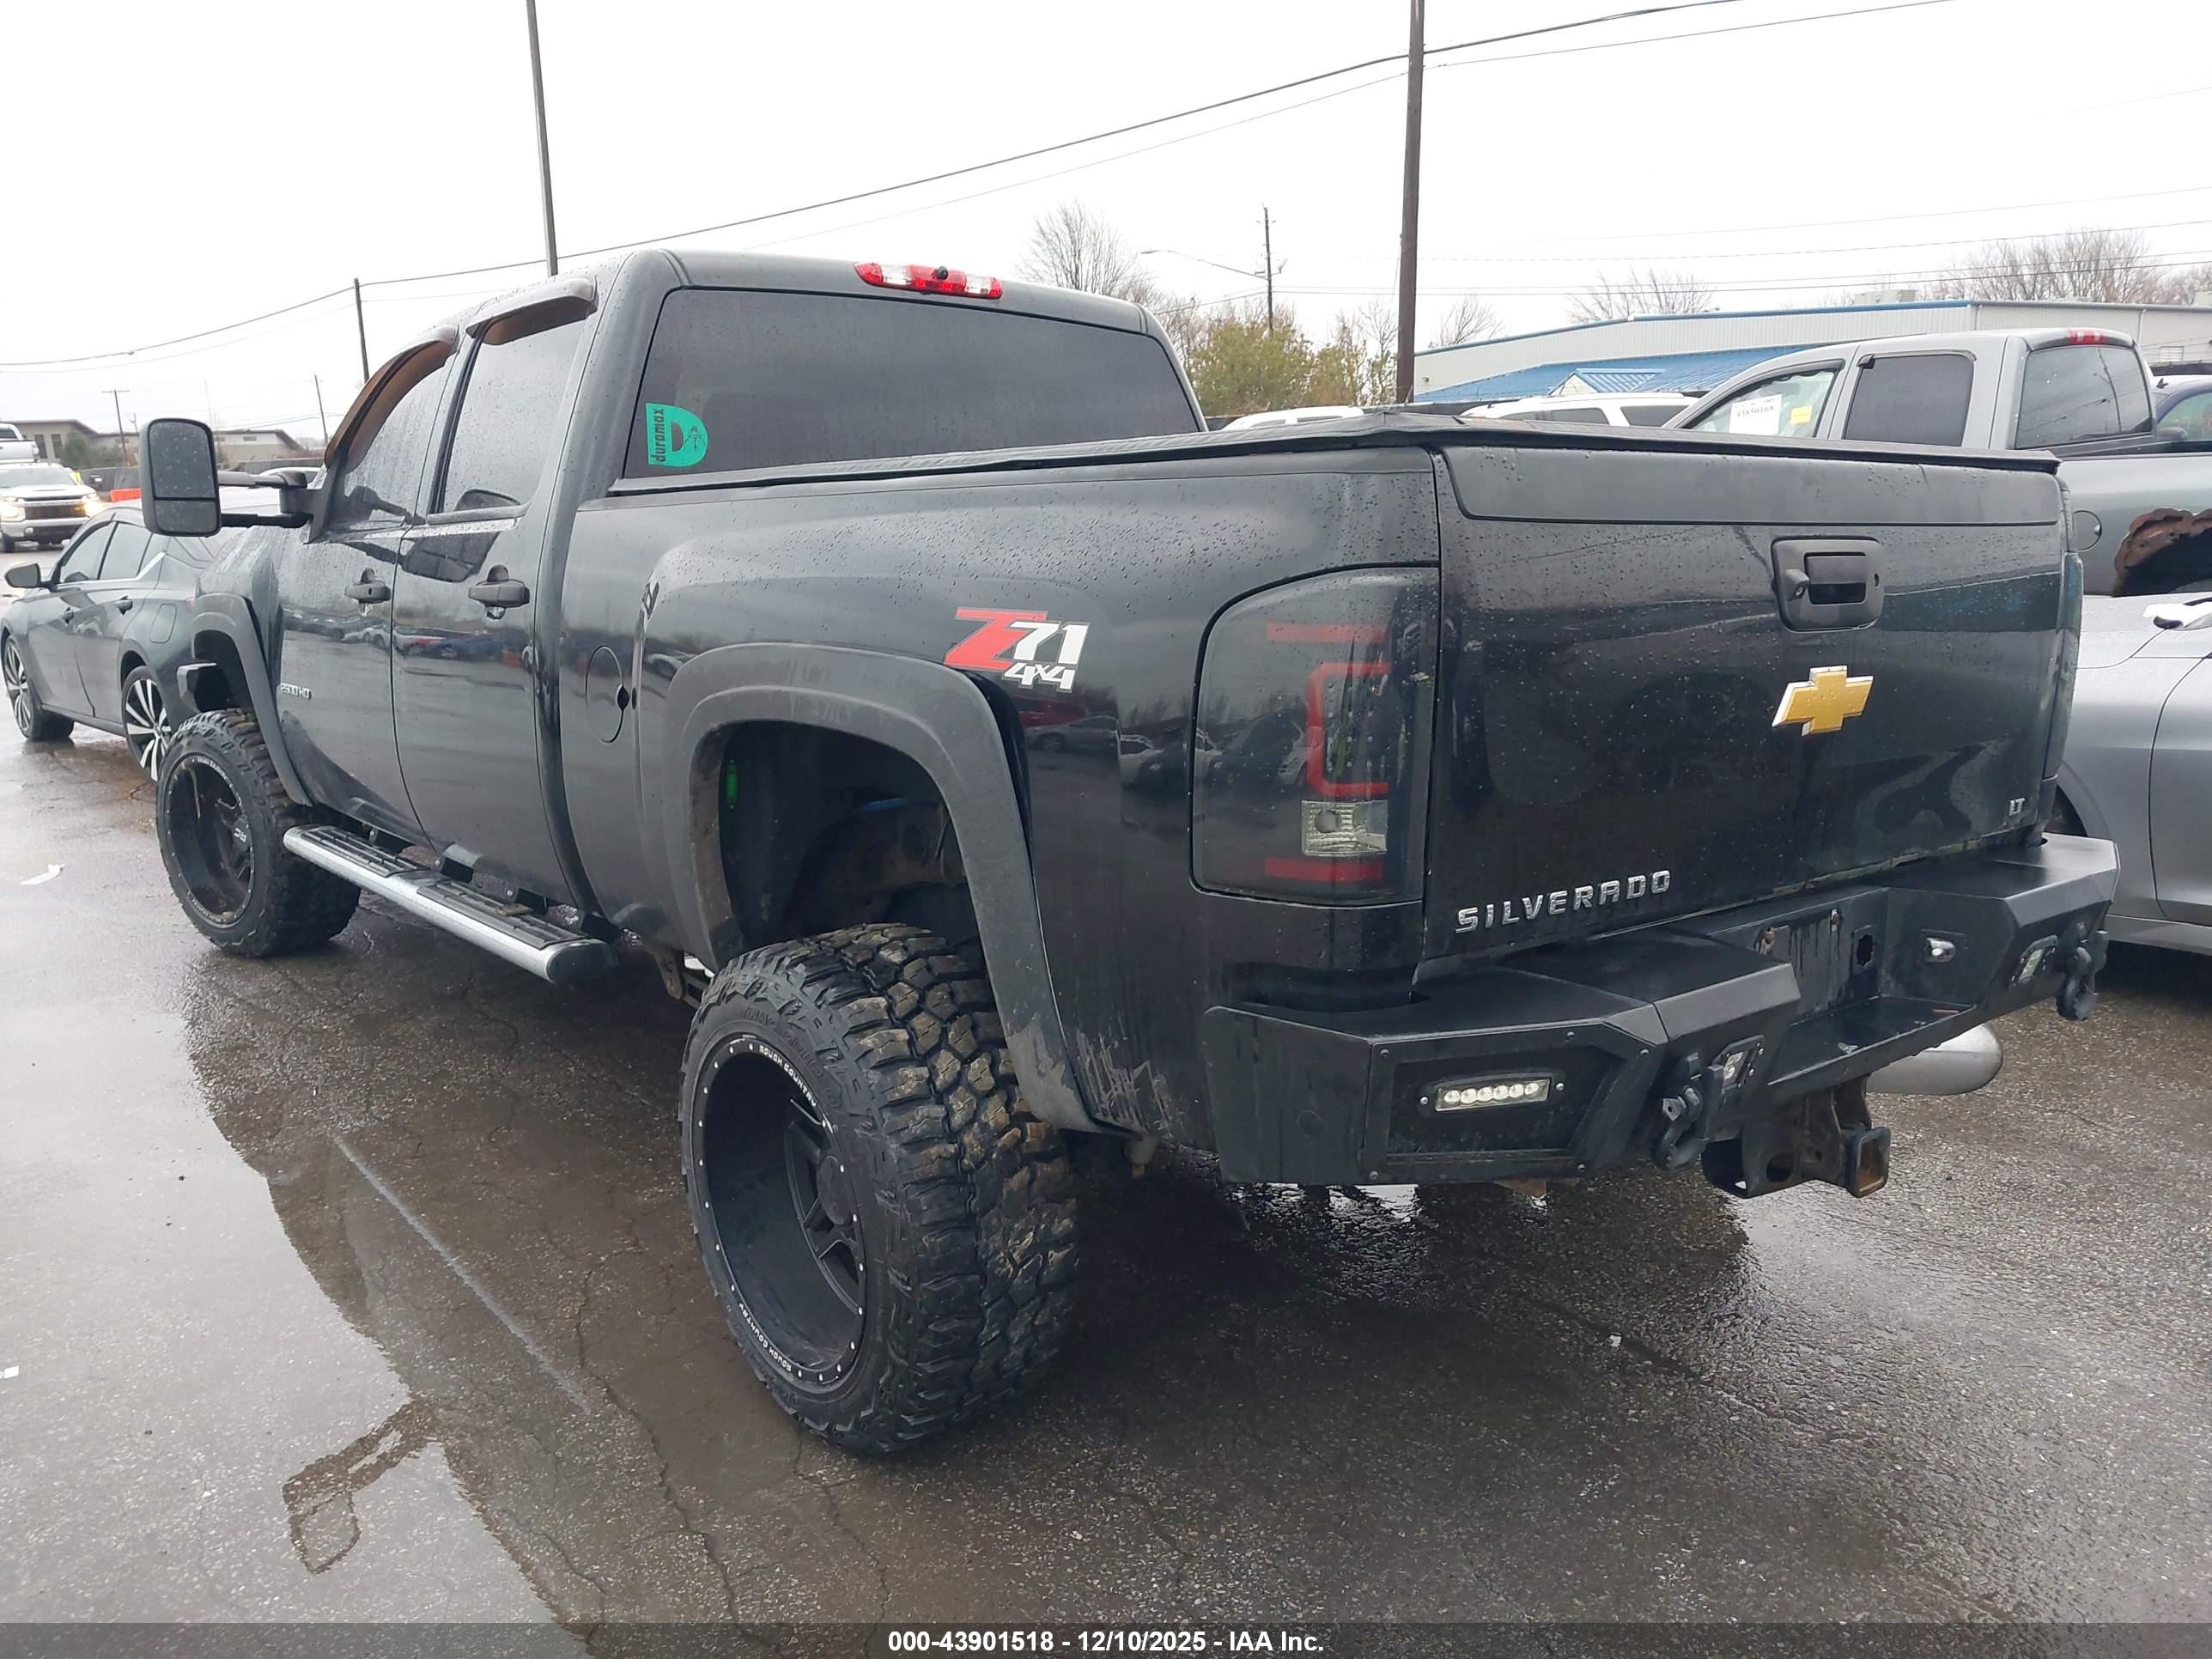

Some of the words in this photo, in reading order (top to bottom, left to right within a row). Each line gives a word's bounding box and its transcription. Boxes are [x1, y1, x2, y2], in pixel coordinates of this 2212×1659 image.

[651, 408, 666, 462] duramax
[944, 606, 1091, 672] Z71
[2008, 797, 2026, 817] LT
[1455, 870, 1671, 933] SILVERADO
[759, 1044, 783, 1066] ROUGH
[783, 1062, 817, 1107] COUNTRY
[738, 1303, 769, 1348] COUNTRY
[769, 1346, 792, 1372] ROUGH
